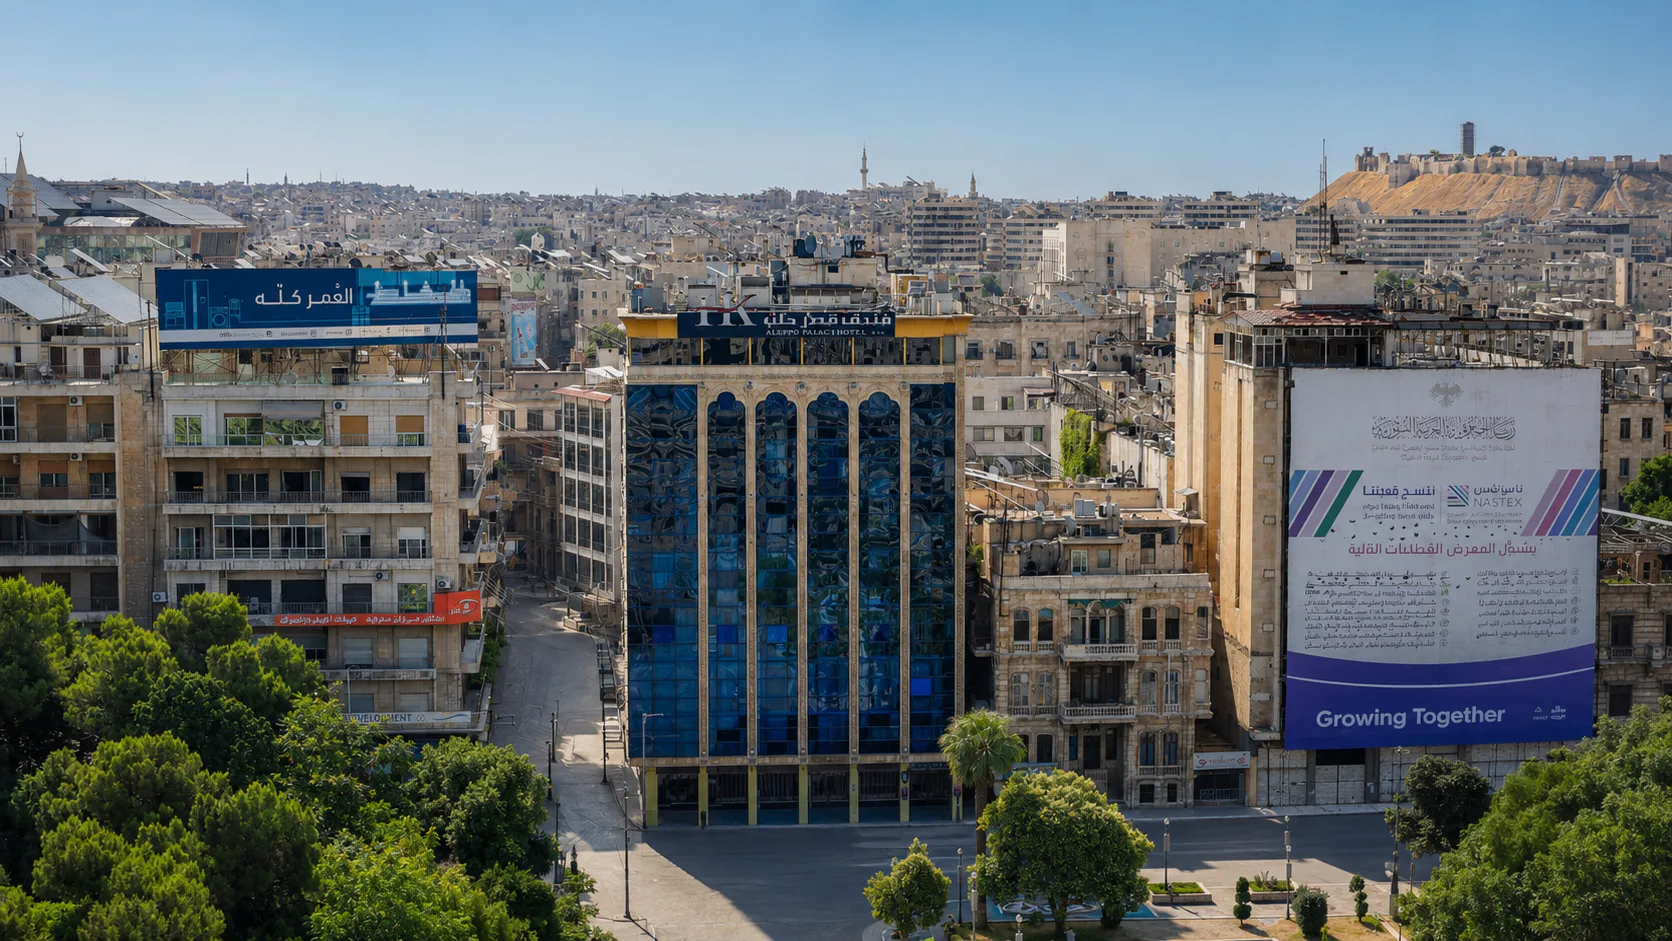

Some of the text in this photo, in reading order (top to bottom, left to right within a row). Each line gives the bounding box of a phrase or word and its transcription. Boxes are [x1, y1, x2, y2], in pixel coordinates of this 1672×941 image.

[1473, 497, 1523, 508] NASTEX
[1316, 706, 1505, 729] Growing Together
